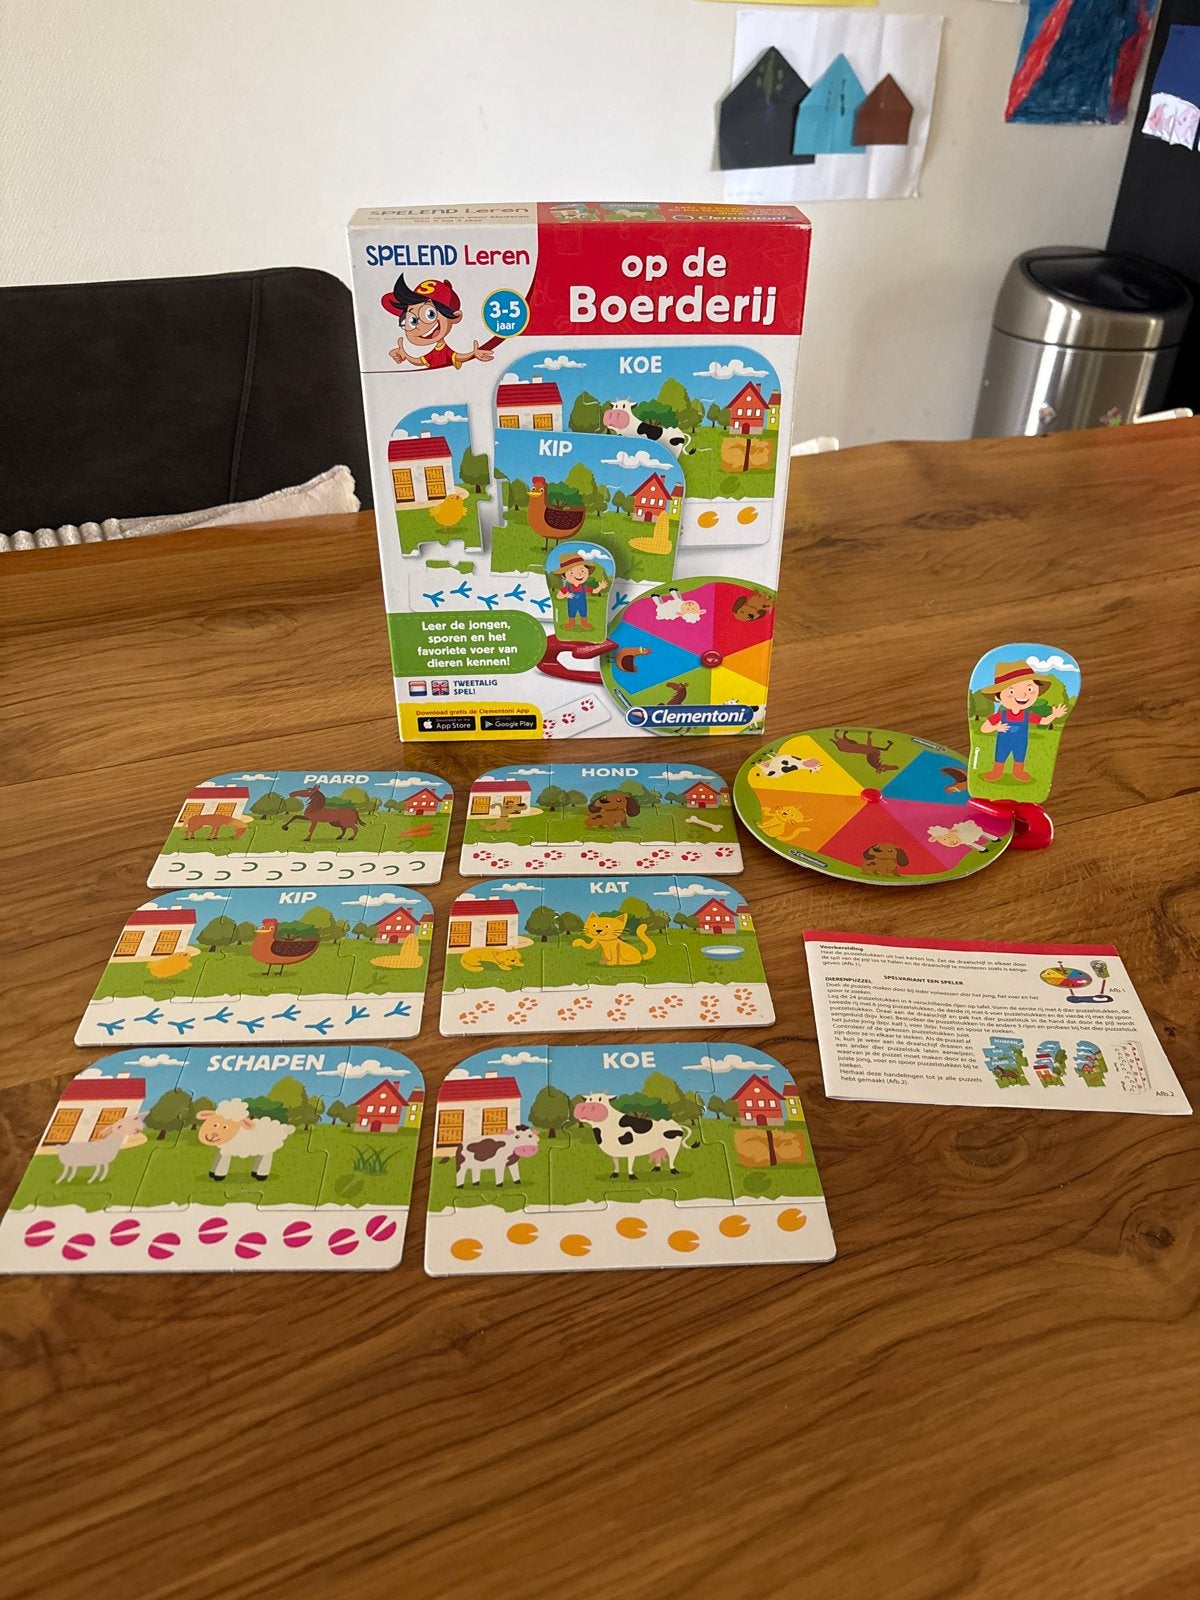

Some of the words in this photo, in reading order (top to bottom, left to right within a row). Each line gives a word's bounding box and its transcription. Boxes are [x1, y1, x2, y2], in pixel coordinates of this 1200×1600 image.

[366, 244, 458, 266] SPELEND
[464, 244, 530, 266] Leren
[622, 254, 668, 281] op
[682, 246, 726, 278] de
[489, 300, 520, 318] 3-5
[569, 285, 776, 326] Boerderij
[496, 320, 516, 332] jaar
[620, 356, 662, 374] KOE
[539, 439, 572, 456] KIP
[422, 622, 446, 630] Leer
[450, 620, 465, 630] de
[468, 620, 510, 631] jongen,
[428, 634, 467, 644] sporen
[470, 634, 484, 642] en
[488, 632, 506, 642] het
[418, 646, 466, 656] favoriete
[470, 646, 495, 654] voer
[498, 646, 518, 654] van
[426, 658, 462, 668] dieren
[466, 656, 510, 666] kennen!
[652, 708, 745, 723] Clementoni
[303, 774, 370, 784] PAARD
[582, 768, 638, 777] HOND
[590, 882, 630, 894] KAT
[279, 892, 317, 904] KIP
[206, 1054, 326, 1072] SCHAPEN
[603, 1051, 656, 1070] KOE
